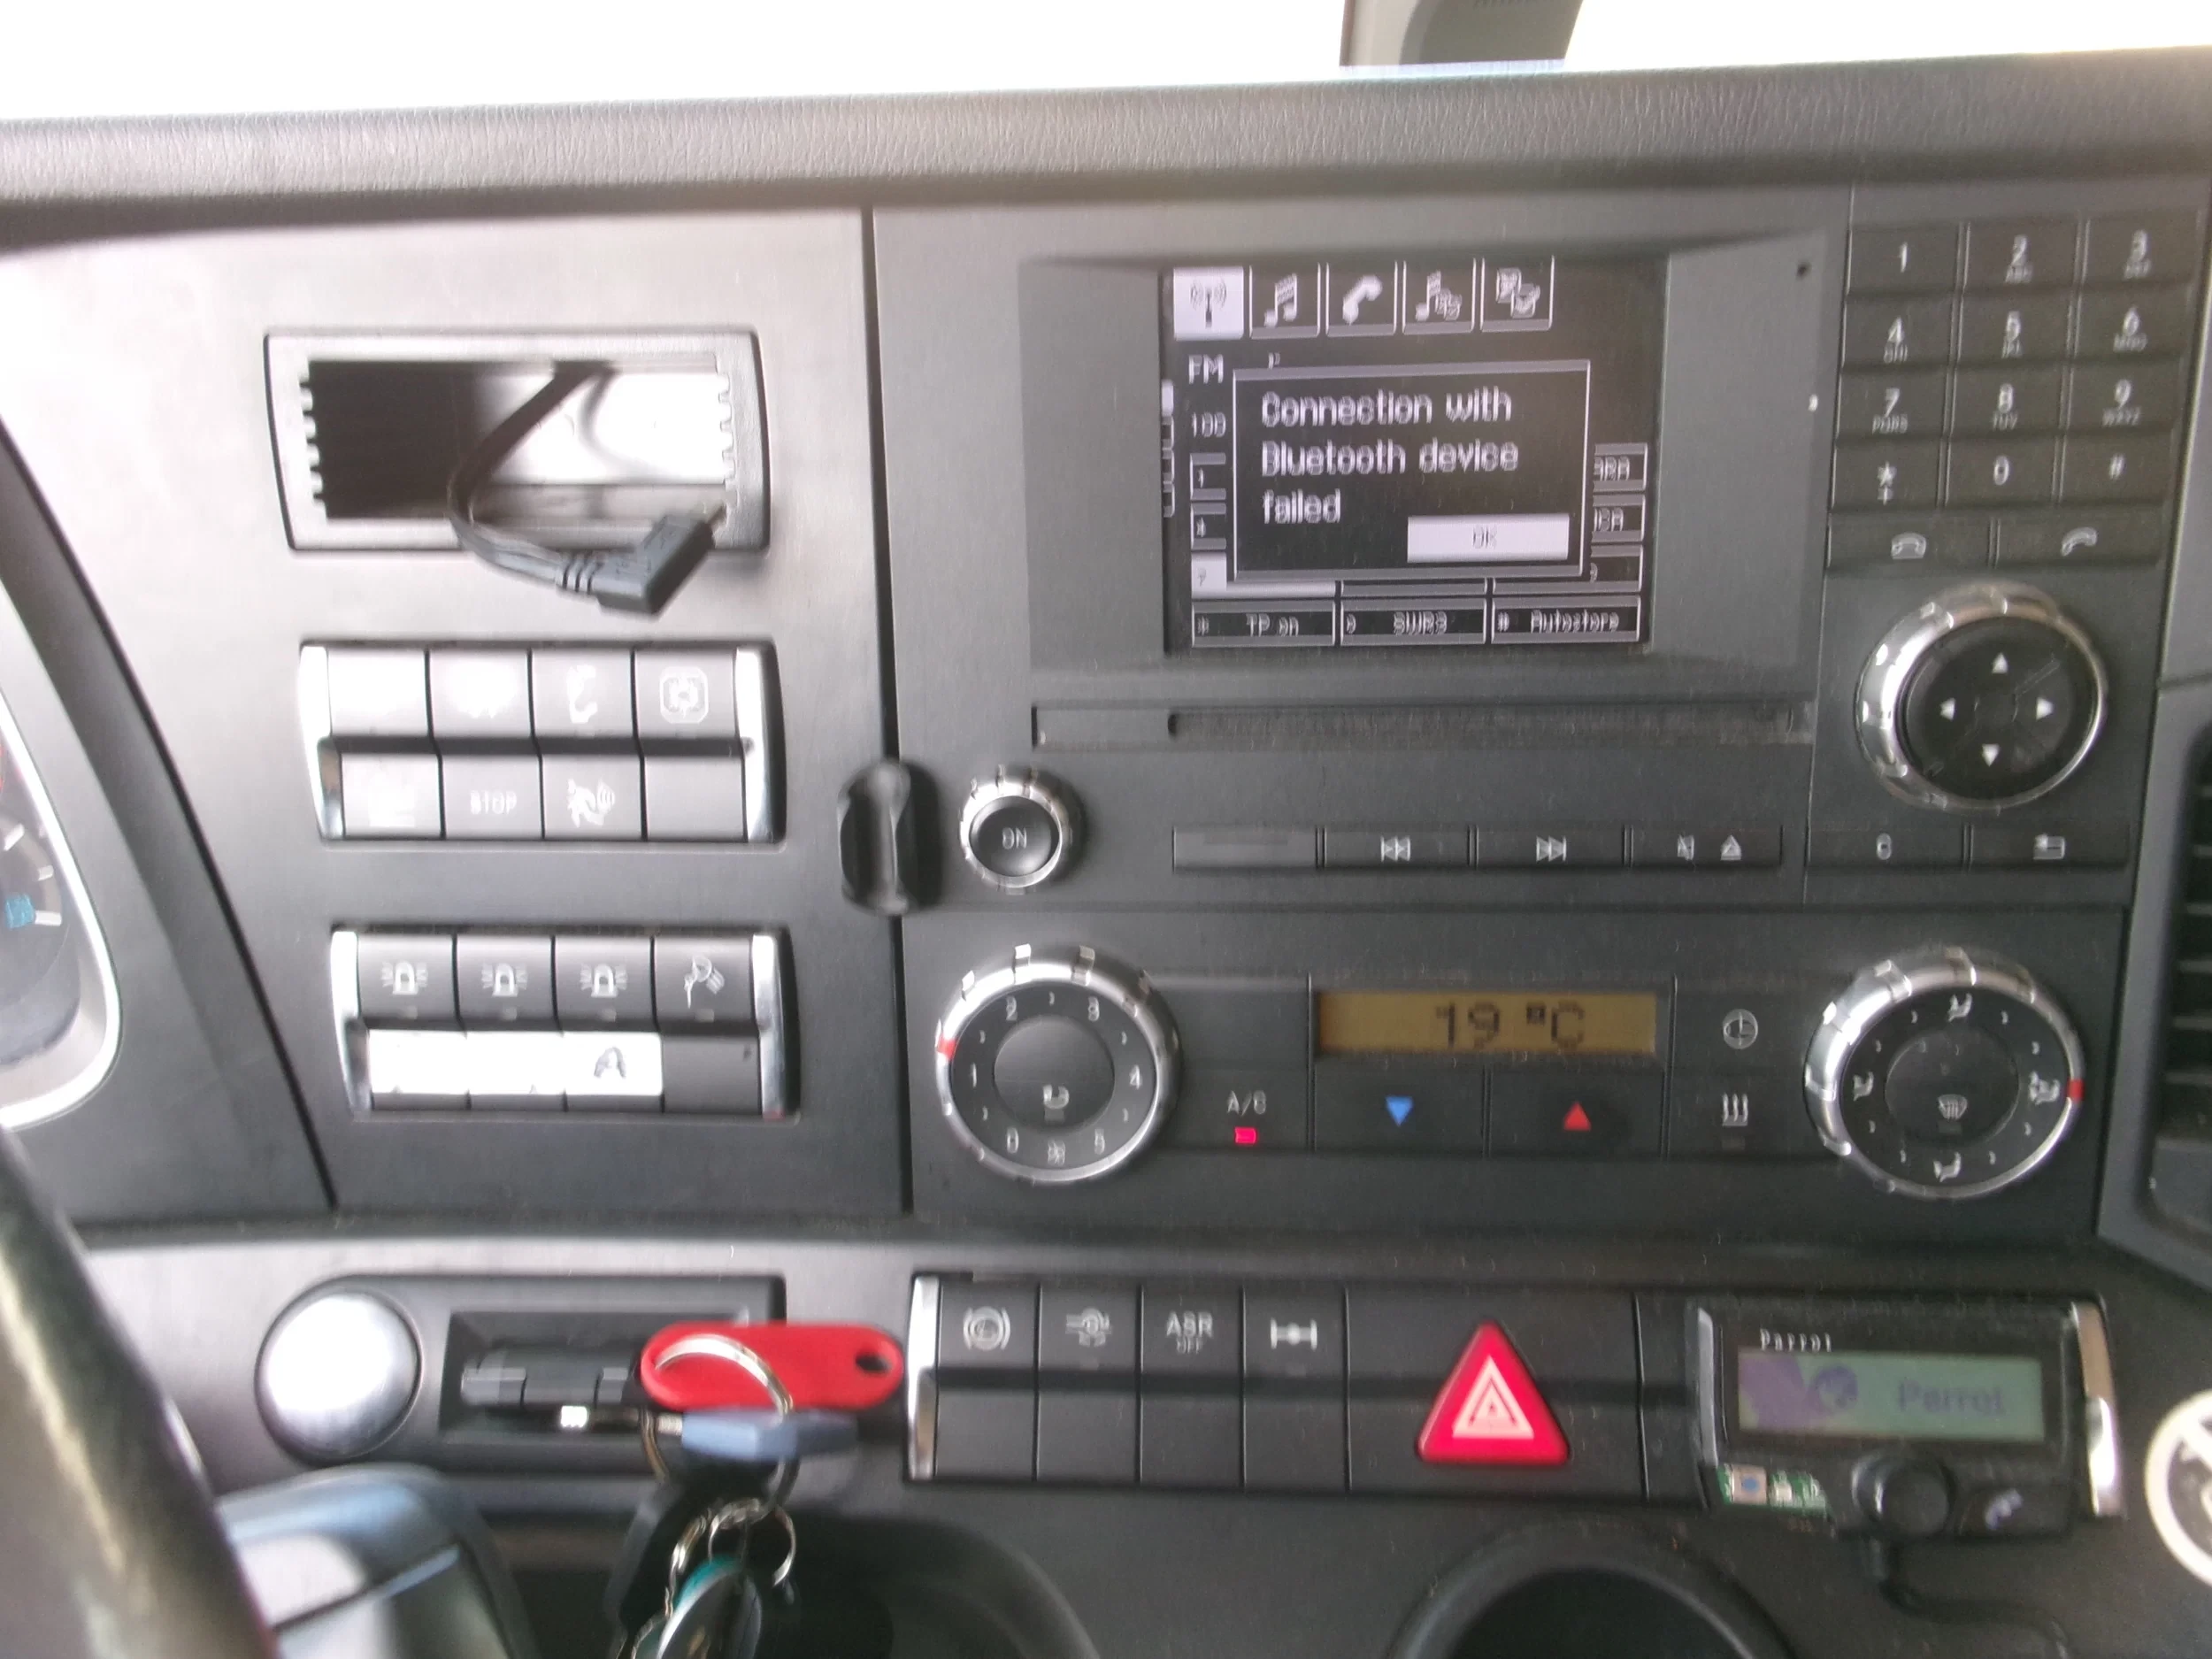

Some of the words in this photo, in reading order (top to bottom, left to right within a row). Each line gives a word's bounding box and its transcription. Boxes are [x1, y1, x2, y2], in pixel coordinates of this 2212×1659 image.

[1899, 242, 1908, 273] 1
[2011, 234, 2028, 265] 2
[1888, 316, 1904, 342] 4
[2005, 311, 2022, 342] 5
[1188, 354, 1224, 385] FM
[1262, 389, 1433, 428] Connection
[1446, 385, 1512, 423] with
[1885, 388, 1900, 418] 7
[1998, 382, 2014, 413] 8
[2115, 379, 2131, 409] 9
[1262, 437, 1407, 477] Bluetooth
[1419, 435, 1519, 473] device
[1993, 455, 2010, 486] 0
[1263, 488, 1340, 525] failed
[1472, 525, 1498, 549] OK
[1530, 609, 1619, 634] Autostore
[470, 790, 518, 815] STOP
[1002, 826, 1028, 849] ON
[1005, 995, 1018, 1022] 2
[1087, 995, 1100, 1023] 3
[1435, 1001, 1502, 1050] 19
[970, 1064, 977, 1088] 1
[1128, 1064, 1142, 1091] 4
[1226, 1089, 1267, 1116] A/C
[1006, 1127, 1019, 1156] 0
[1166, 1311, 1213, 1337] ASR
[1899, 1379, 2005, 1416] Parrot
